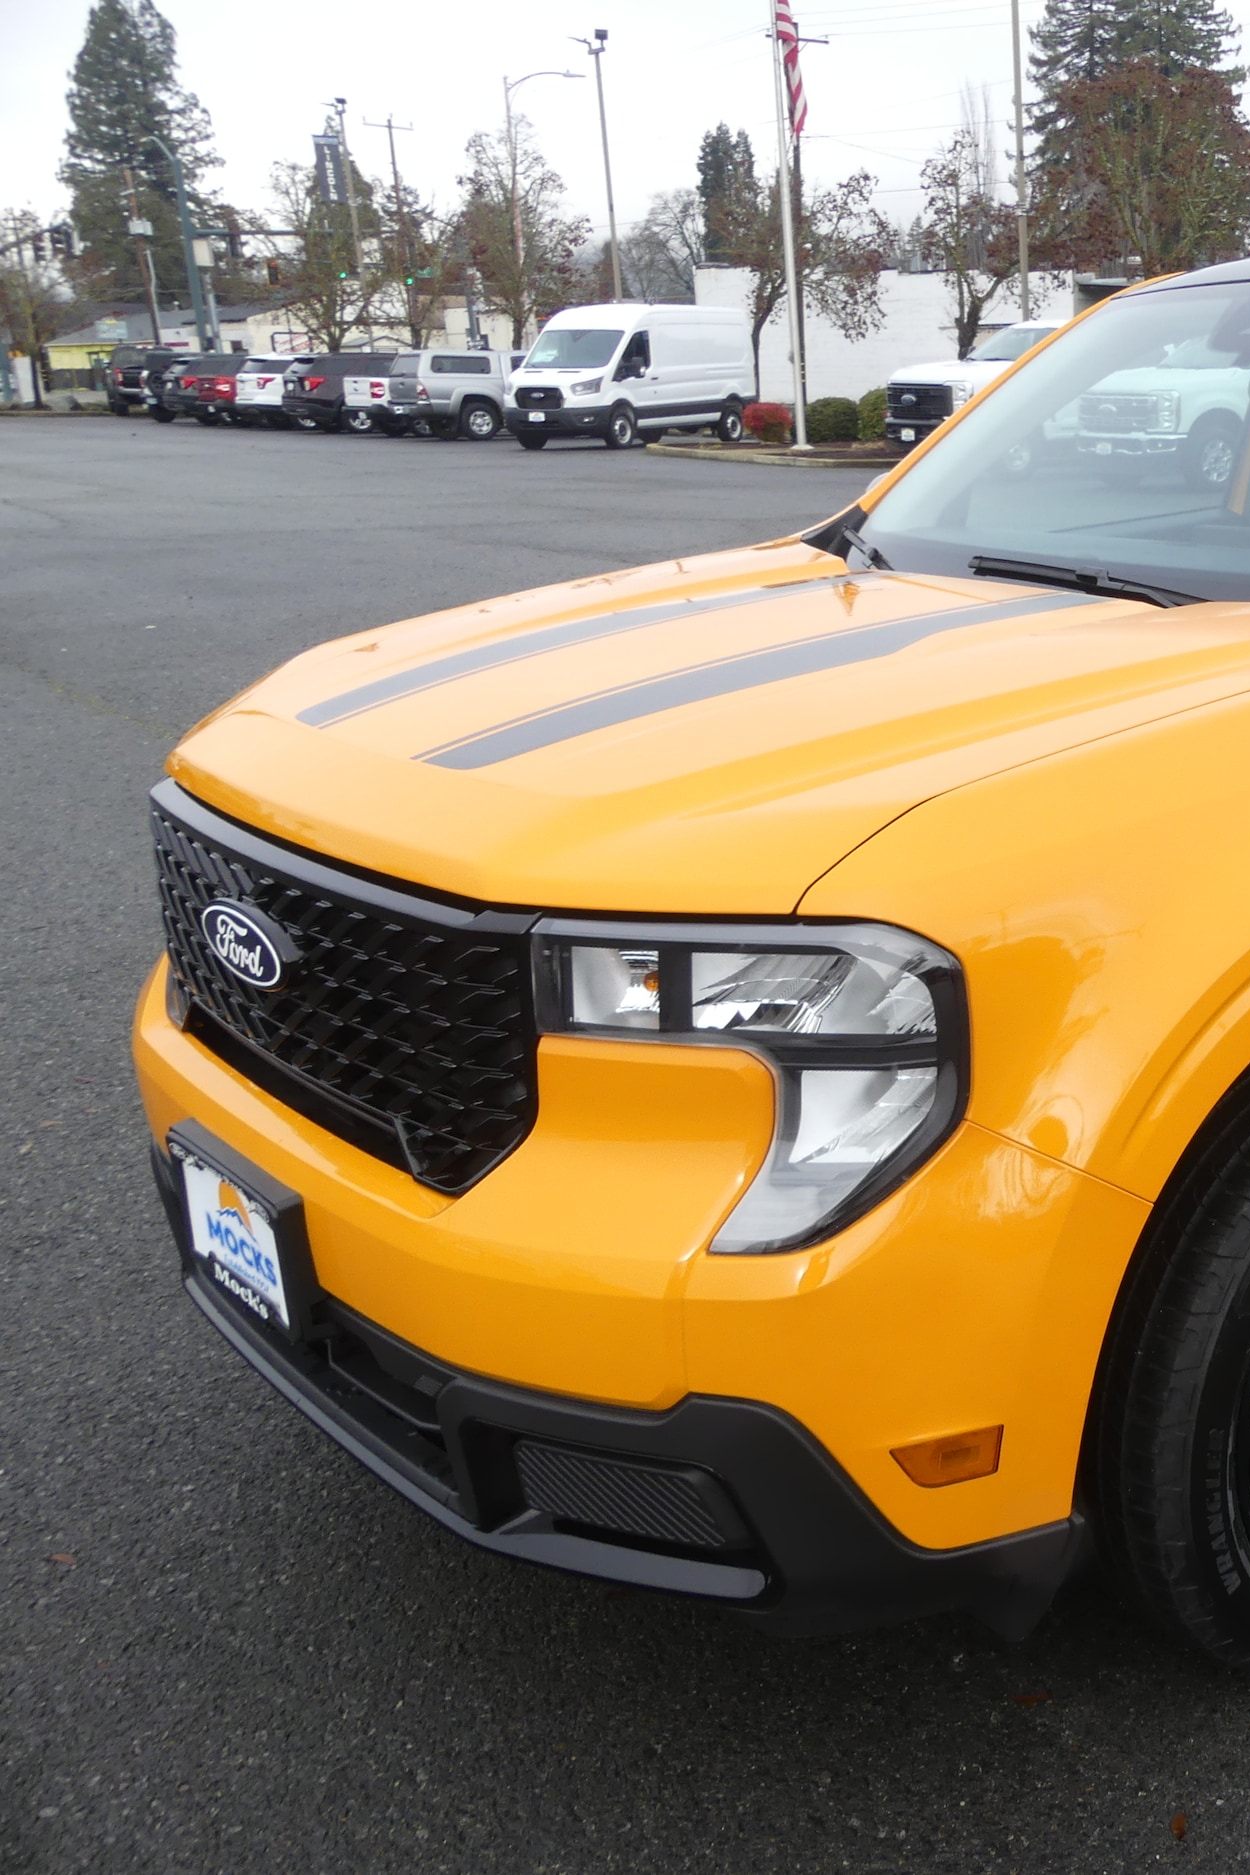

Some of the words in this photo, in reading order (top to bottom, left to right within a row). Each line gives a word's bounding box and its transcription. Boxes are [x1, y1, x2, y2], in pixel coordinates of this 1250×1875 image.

[216, 914, 264, 978] Ford
[206, 1210, 277, 1287] MOCKS
[214, 1261, 270, 1321] Mock's
[1205, 1427, 1242, 1595] WRANGLER
